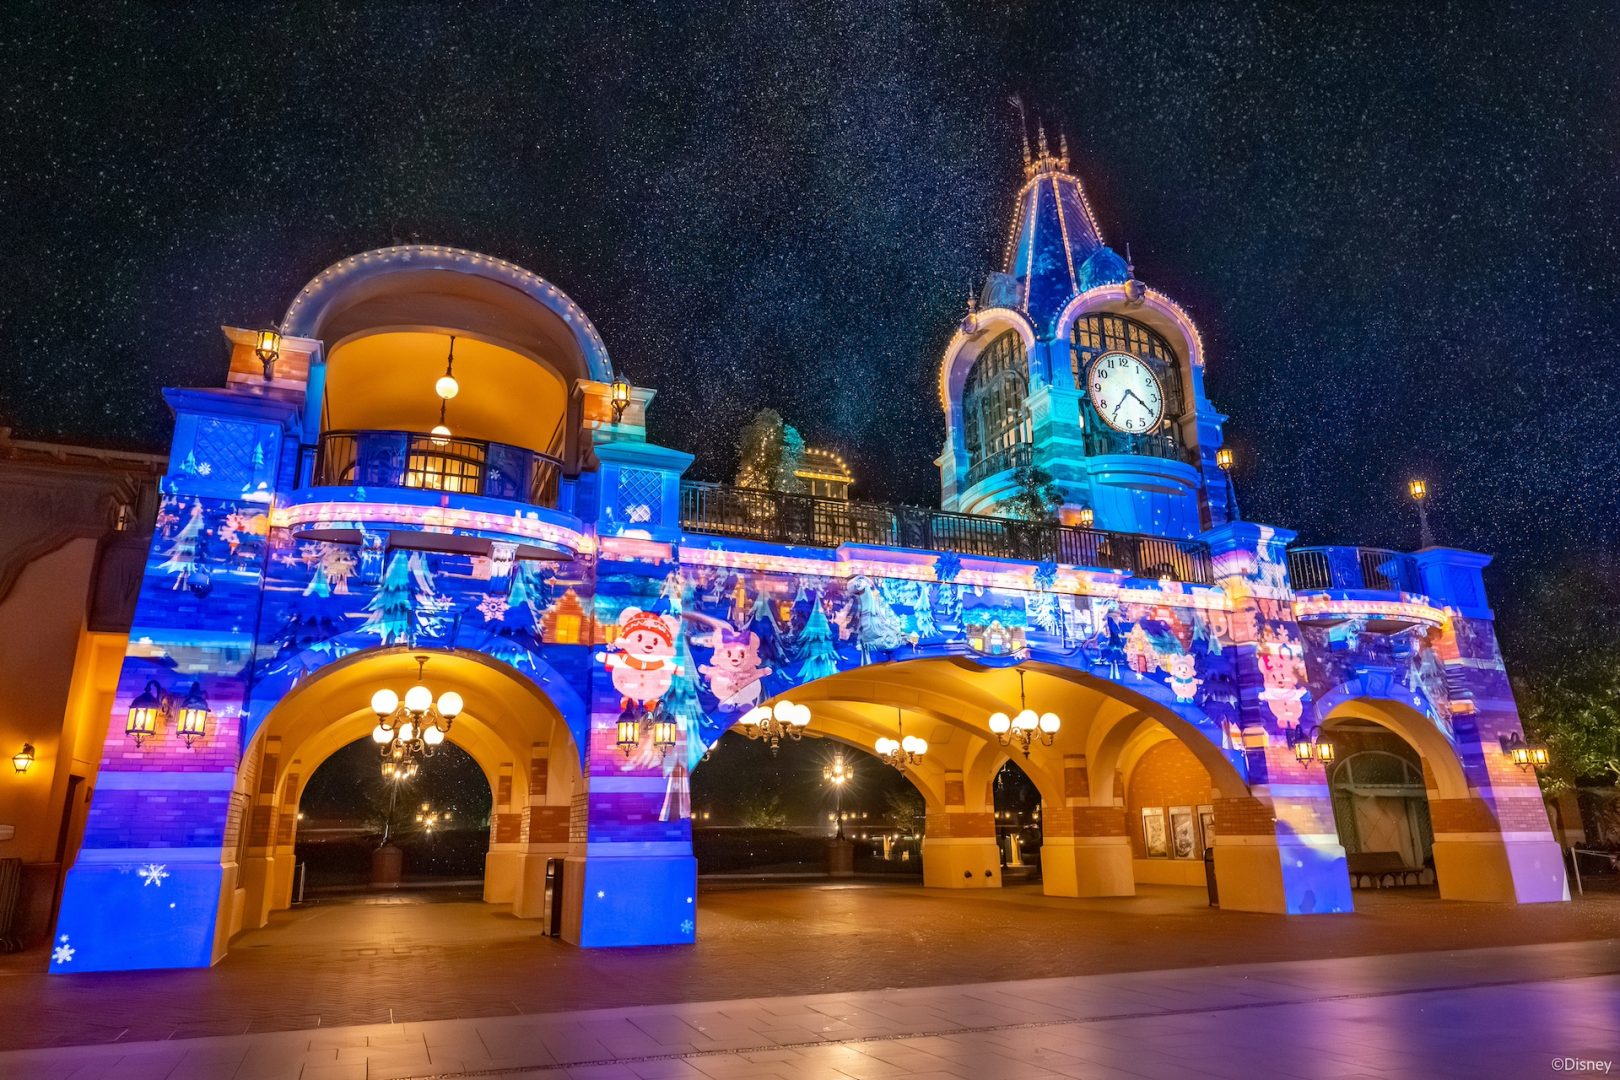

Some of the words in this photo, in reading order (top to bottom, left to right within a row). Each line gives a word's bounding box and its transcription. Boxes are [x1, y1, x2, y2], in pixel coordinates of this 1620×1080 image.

[1107, 359, 1114, 368] 11
[1119, 358, 1129, 367] 12
[1098, 369, 1108, 378] 10
[1136, 366, 1139, 374] 1
[1146, 378, 1152, 387] 2
[1095, 383, 1101, 392] 9
[1150, 394, 1157, 403] 3
[1100, 400, 1107, 409] 8
[1112, 412, 1118, 422] 7
[1126, 420, 1133, 429] 6
[1139, 418, 1146, 427] 5
